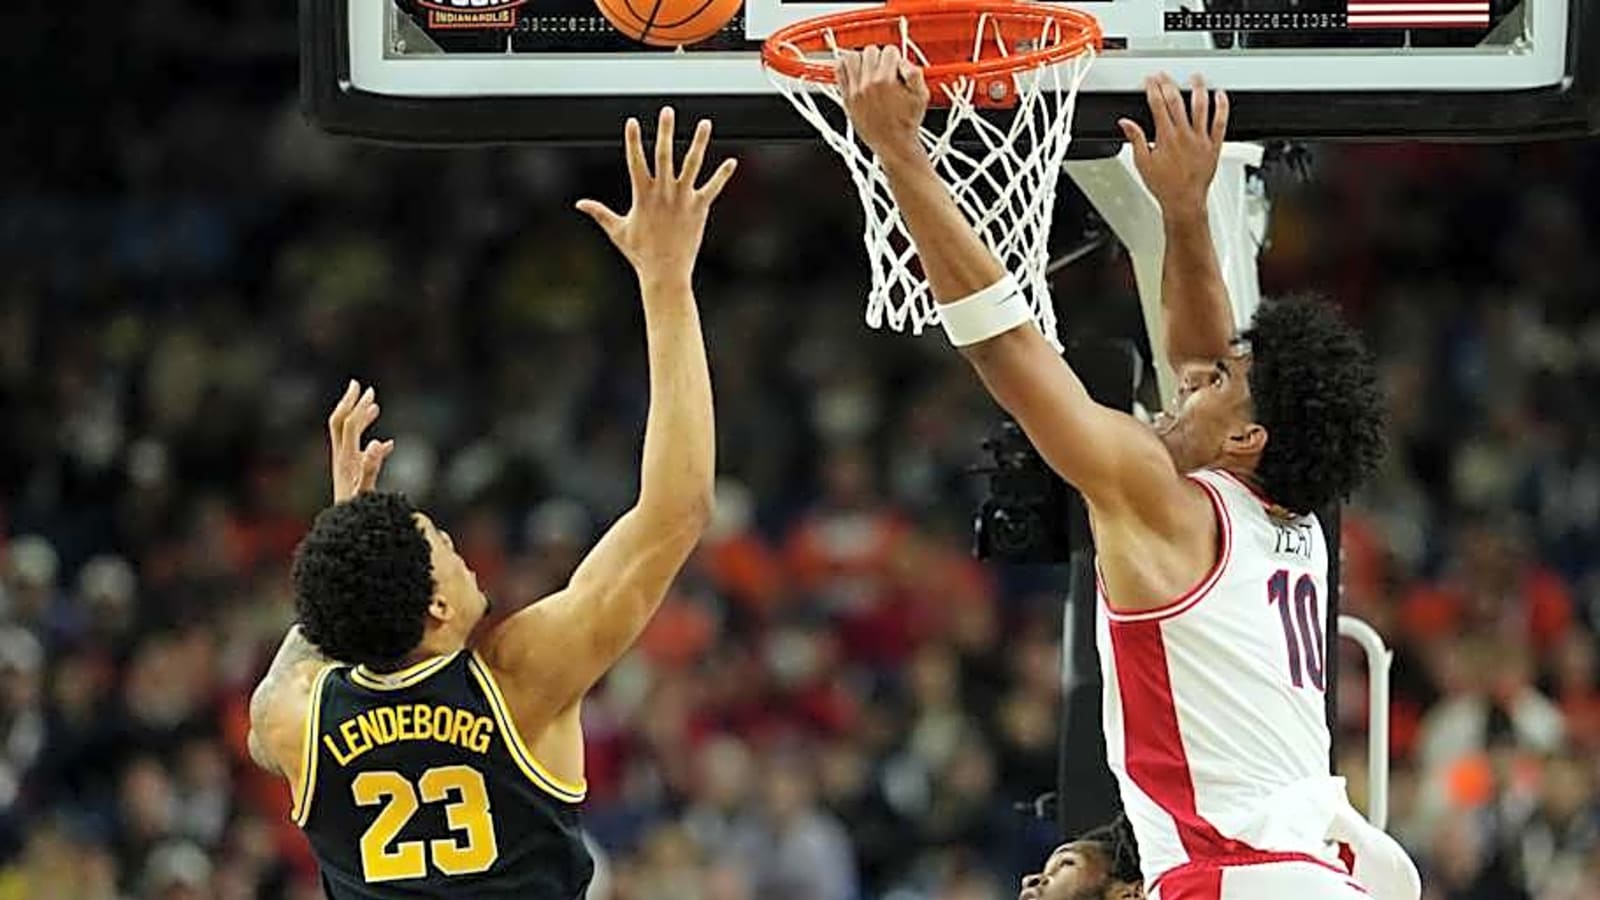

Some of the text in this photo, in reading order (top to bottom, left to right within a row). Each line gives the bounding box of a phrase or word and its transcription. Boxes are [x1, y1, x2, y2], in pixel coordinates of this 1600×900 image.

[435, 10, 509, 22] INDIANAPOLIS
[1267, 569, 1324, 691] 10
[323, 704, 494, 766] LENDEBORG
[351, 765, 498, 883] 23
